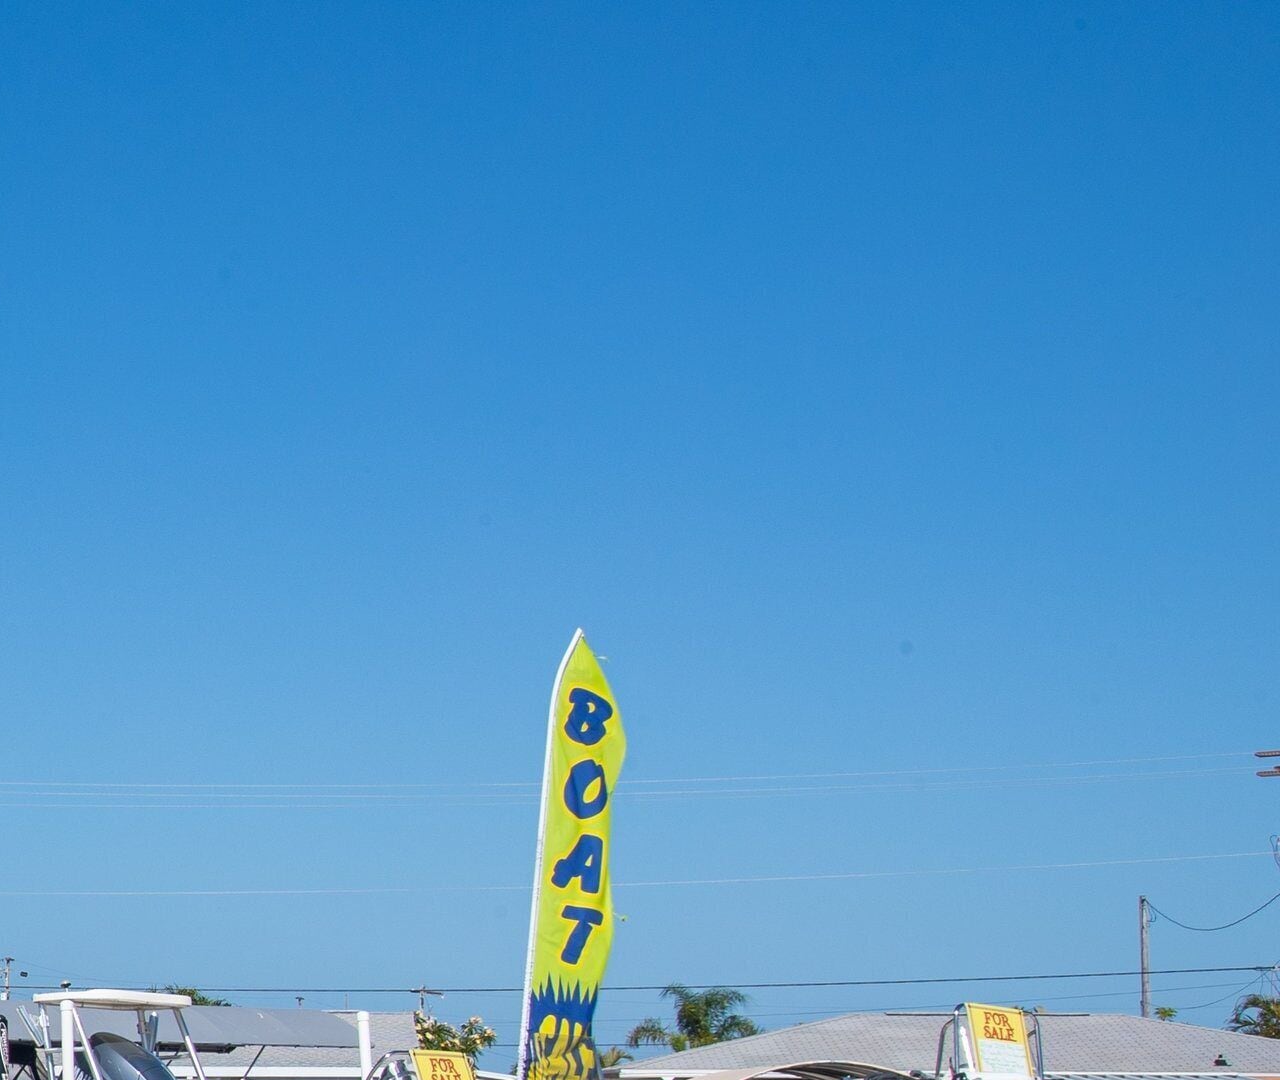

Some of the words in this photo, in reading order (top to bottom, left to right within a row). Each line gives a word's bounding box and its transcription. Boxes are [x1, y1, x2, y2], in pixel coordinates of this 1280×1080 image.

[551, 686, 613, 966] BOAT
[984, 1011, 1012, 1029] FOR
[983, 1025, 1018, 1043] SALE
[429, 1058, 459, 1075] FOR
